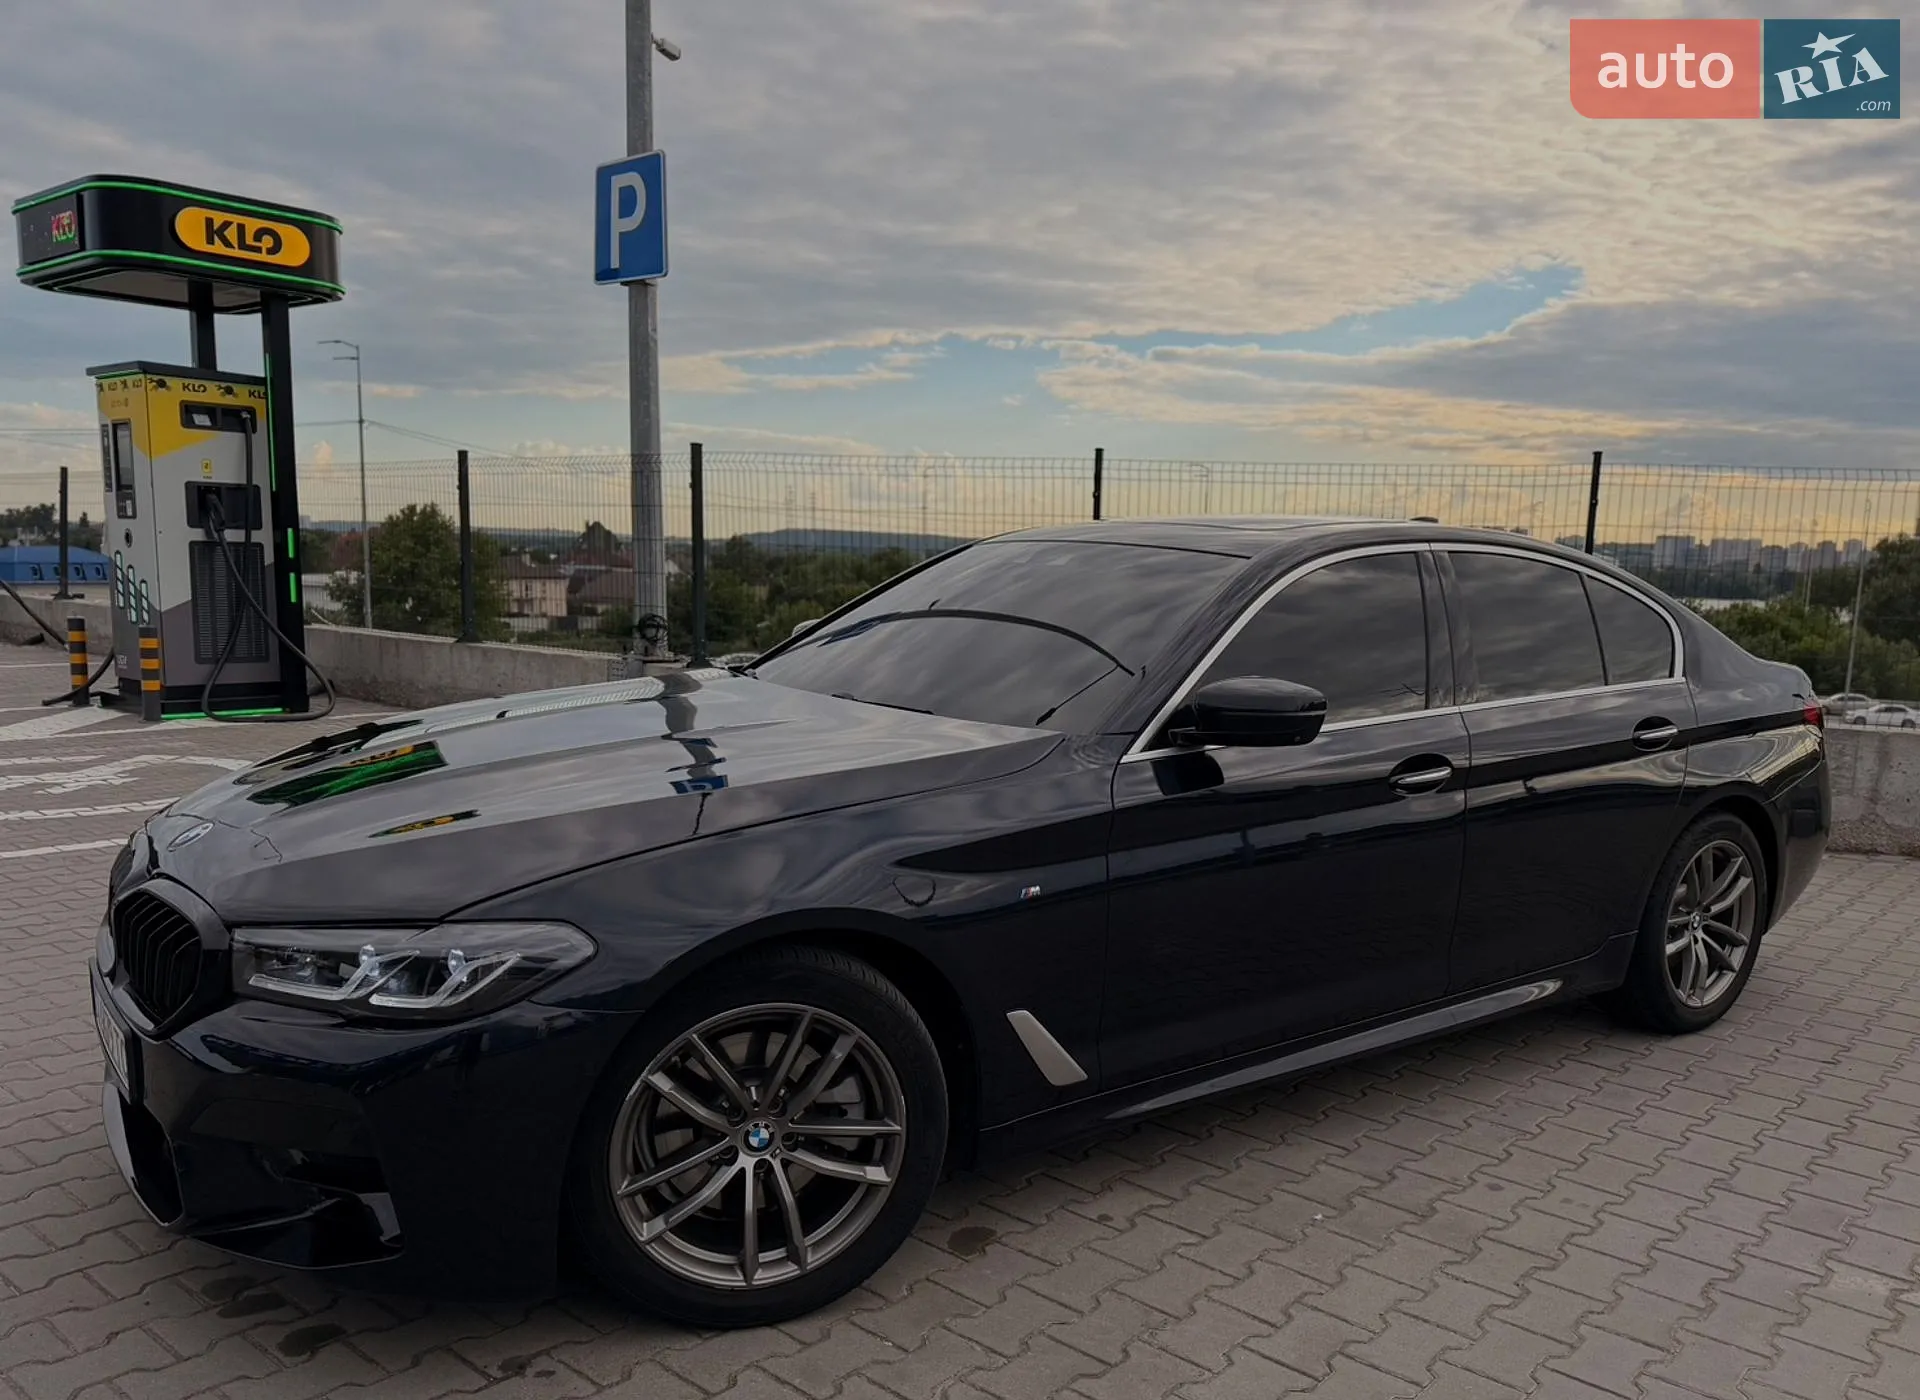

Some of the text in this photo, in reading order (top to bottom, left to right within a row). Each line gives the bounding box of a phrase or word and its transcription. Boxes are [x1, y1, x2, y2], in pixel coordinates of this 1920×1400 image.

[204, 216, 283, 255] KLO
[610, 171, 646, 269] P
[182, 382, 207, 393] KLO
